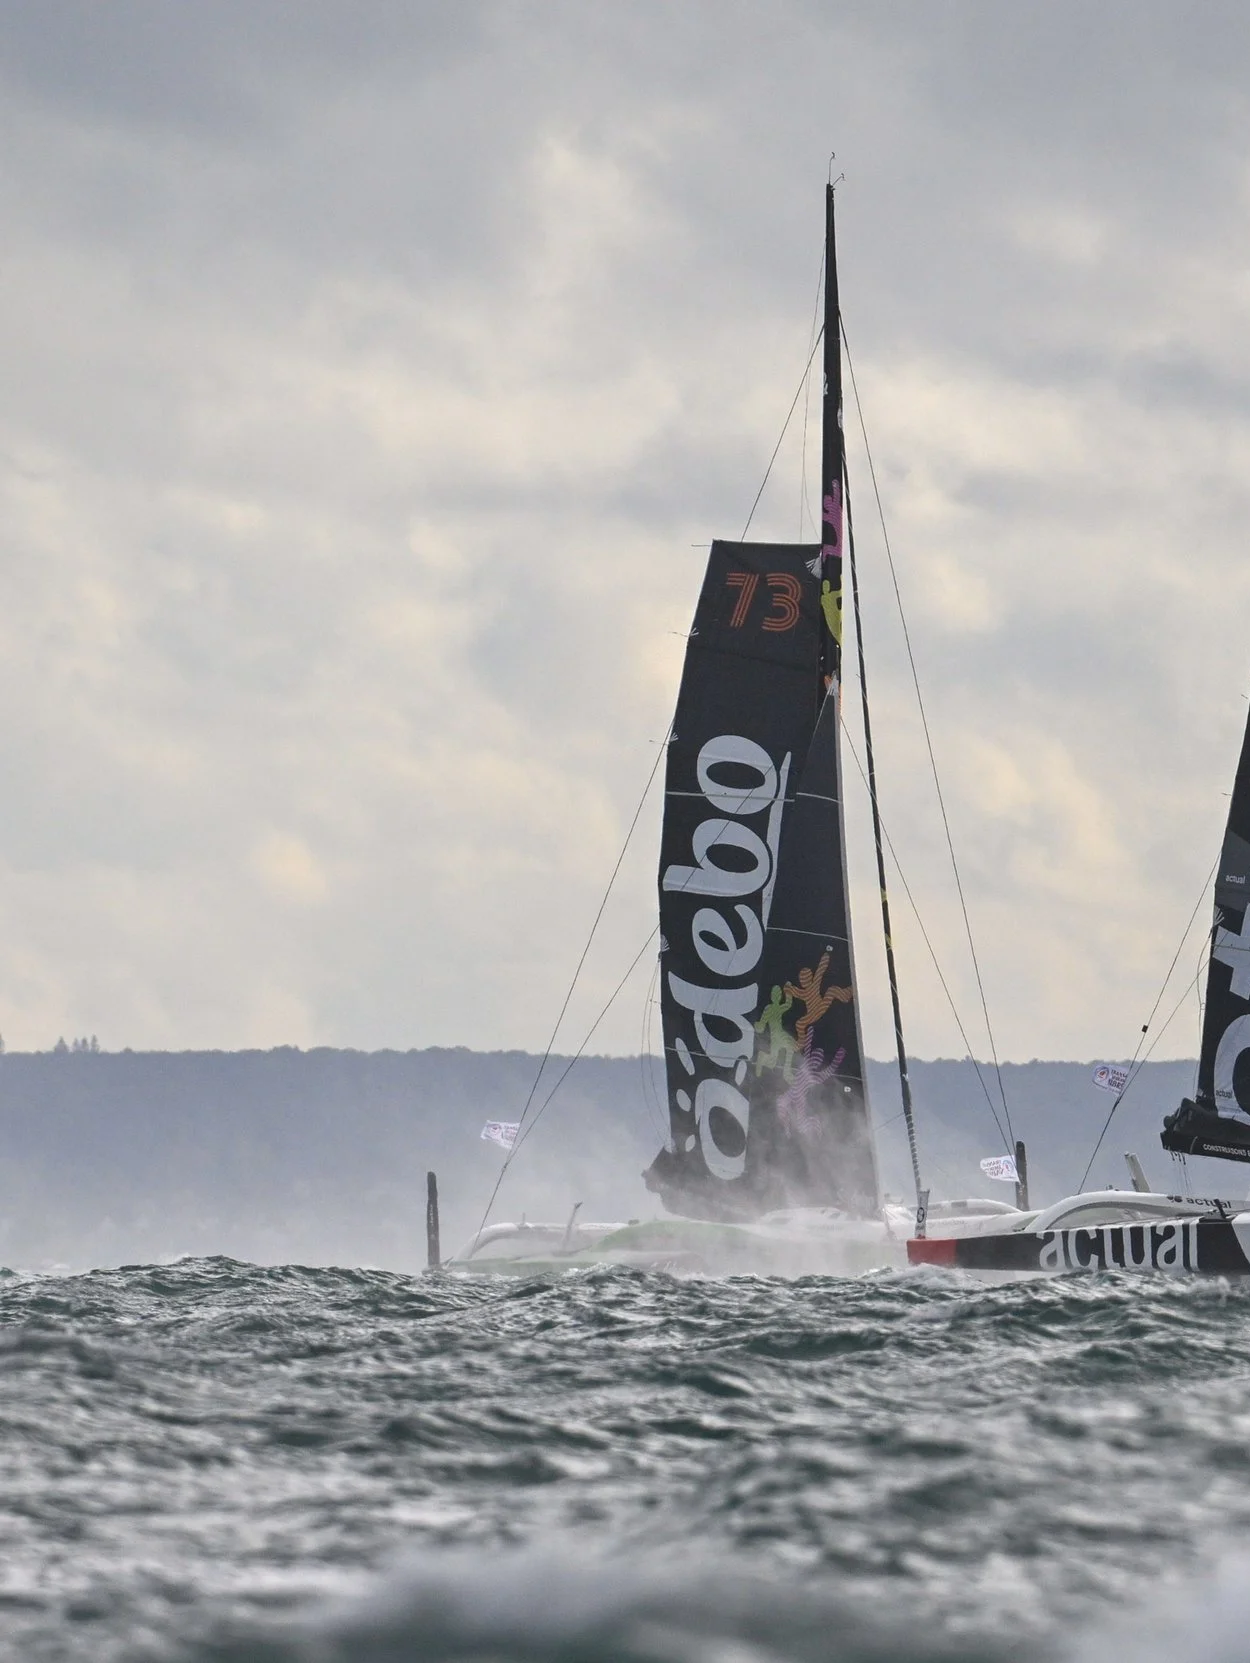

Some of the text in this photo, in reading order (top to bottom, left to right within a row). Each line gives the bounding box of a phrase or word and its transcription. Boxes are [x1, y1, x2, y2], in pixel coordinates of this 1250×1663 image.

[725, 572, 801, 632] 73
[1226, 874, 1246, 884] actual
[1203, 1143, 1247, 1157] CONSTRUISONS
[1036, 1217, 1200, 1275] actual
